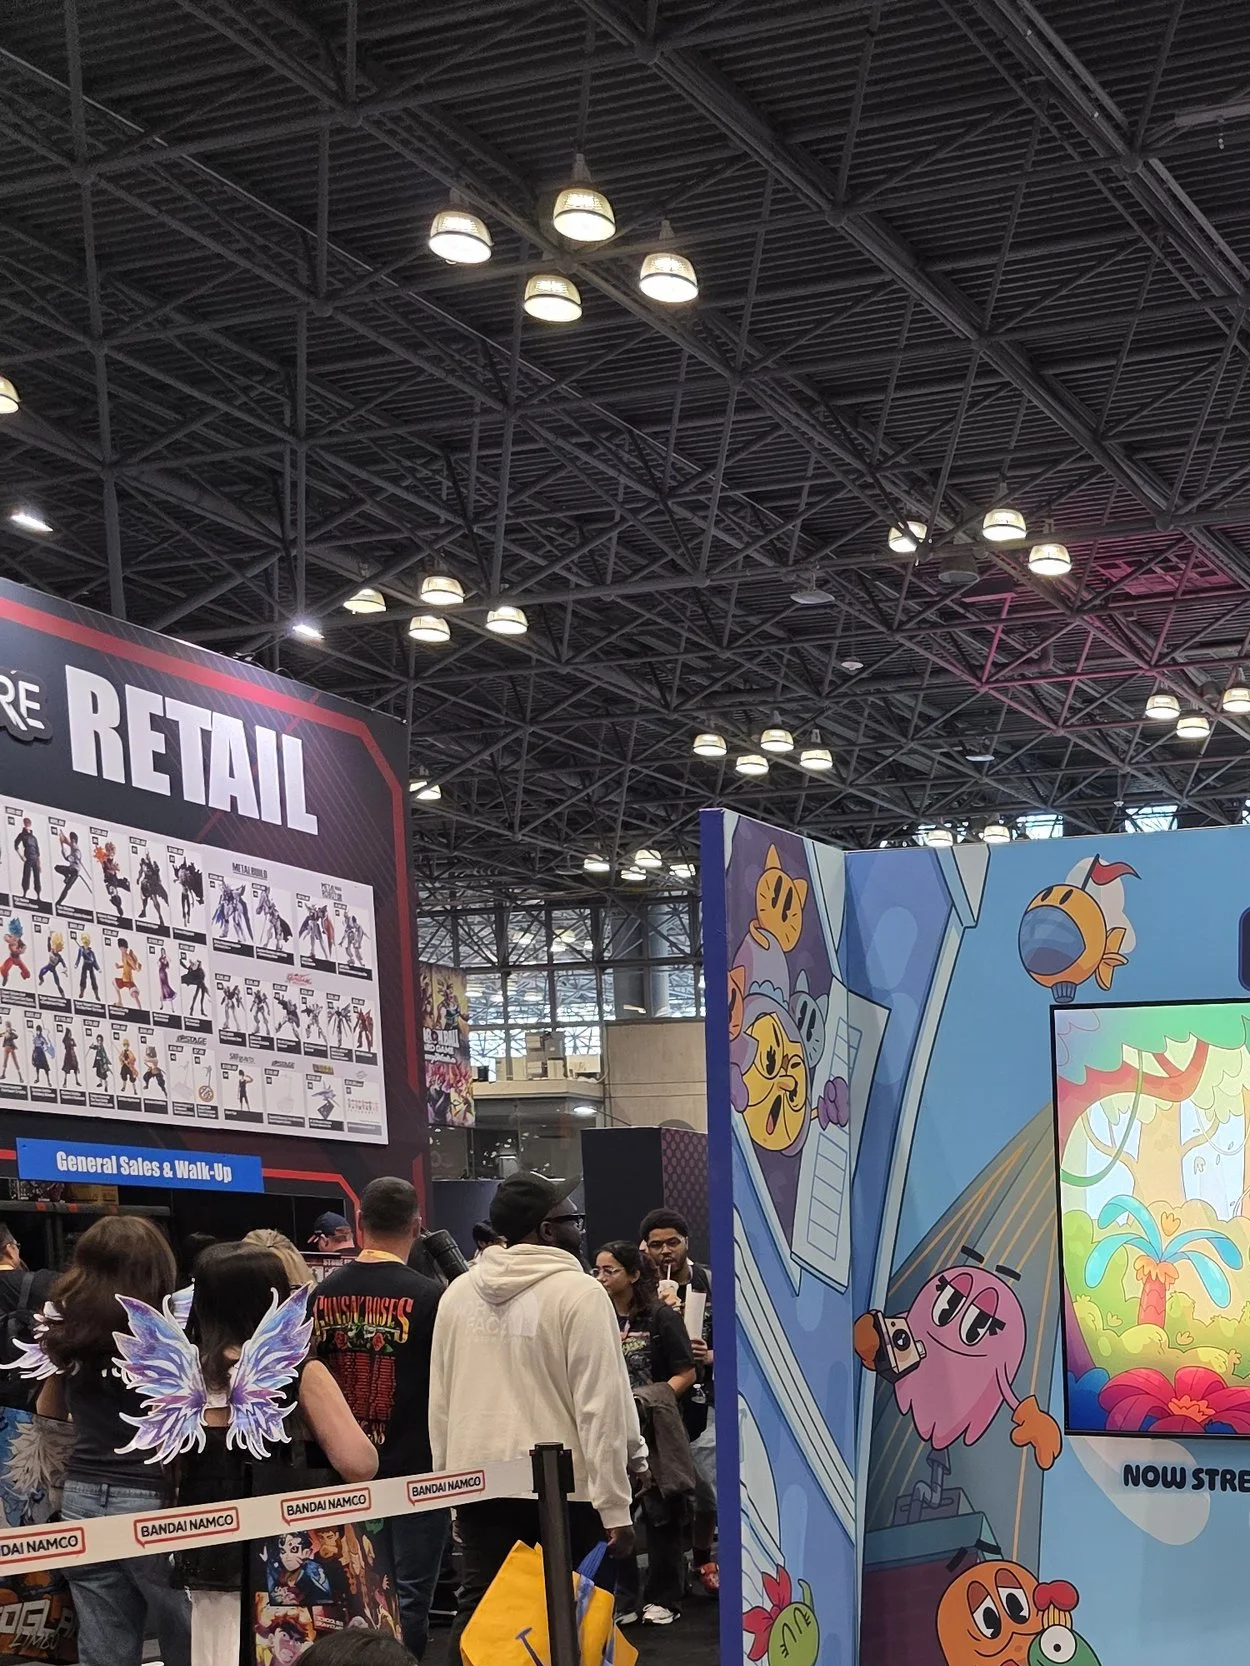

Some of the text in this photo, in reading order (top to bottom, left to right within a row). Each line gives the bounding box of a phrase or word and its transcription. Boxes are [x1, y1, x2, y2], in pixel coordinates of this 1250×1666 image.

[65, 664, 319, 836] RETAIL
[56, 1150, 233, 1184] General Sales & Walk-Up
[412, 1475, 481, 1498] BANDAI NAMCO
[1123, 1464, 1187, 1490] NOW
[286, 1493, 367, 1517] BANDAI NAMCO
[140, 1513, 234, 1539] BANDAI NAMCO
[26, 1534, 79, 1554] NAMCO
